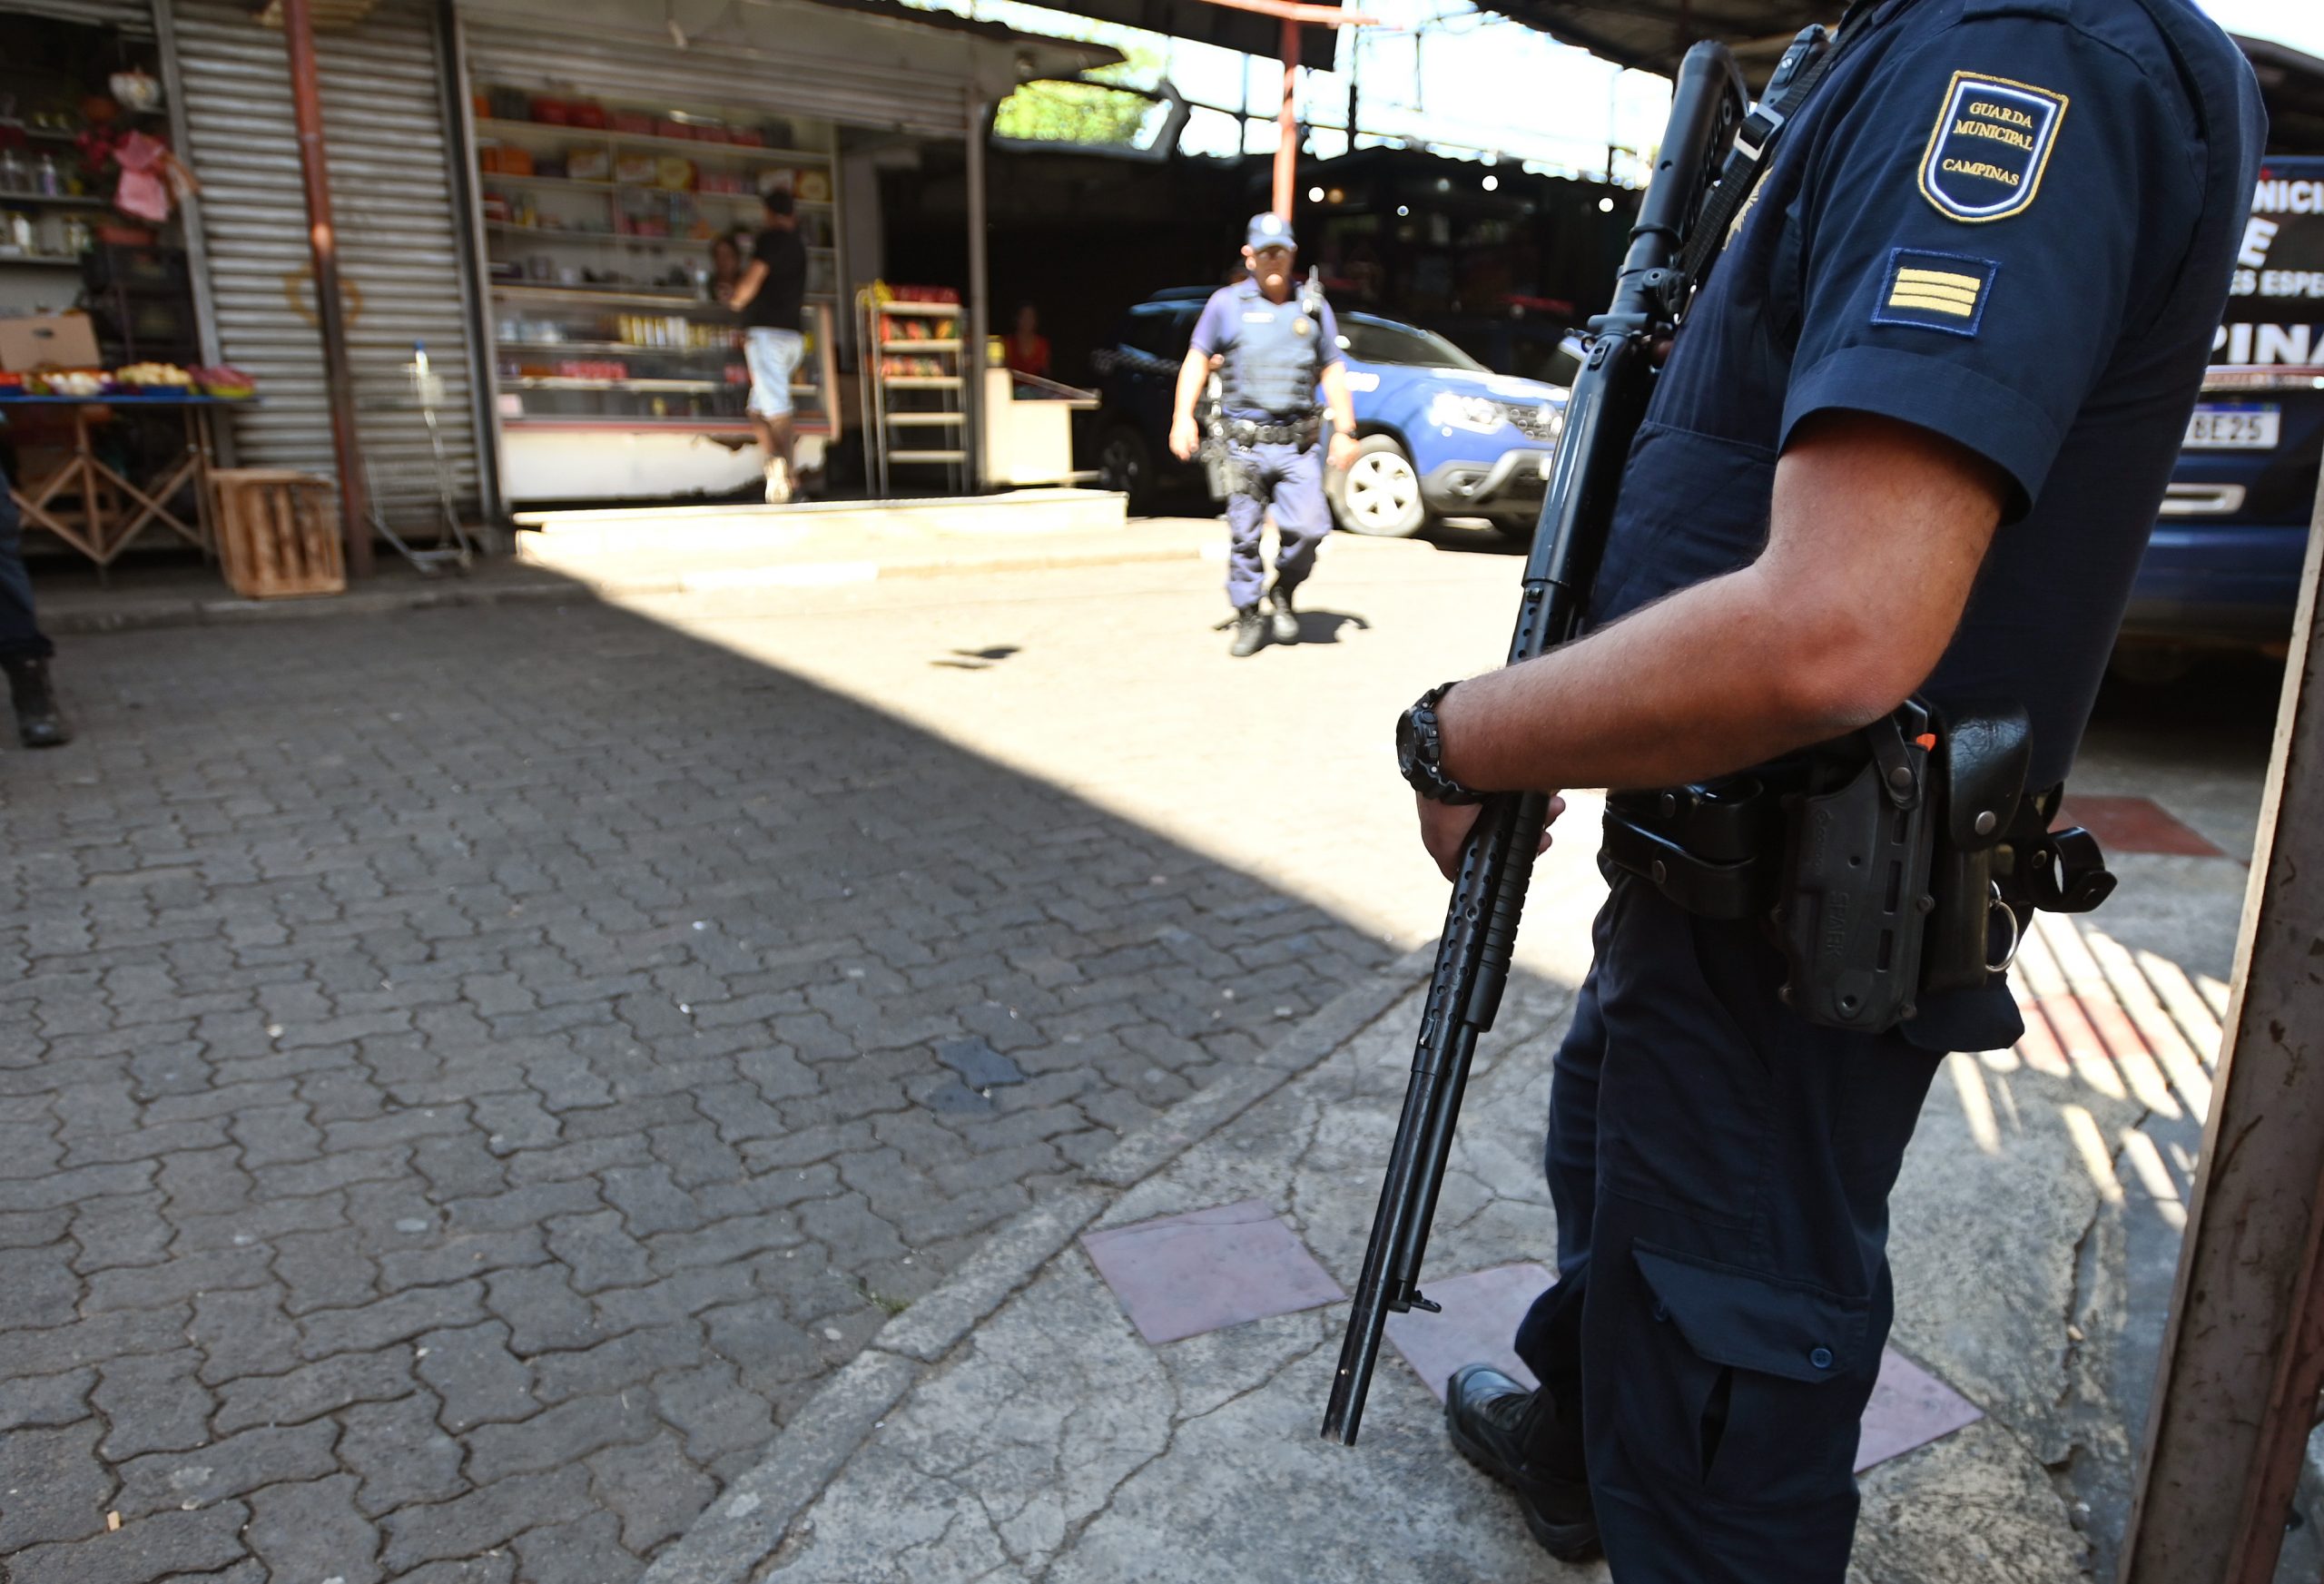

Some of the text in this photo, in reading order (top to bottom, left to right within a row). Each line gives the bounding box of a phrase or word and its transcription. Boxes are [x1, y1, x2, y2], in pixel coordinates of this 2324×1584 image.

[1969, 101, 2033, 128] GUARDA
[1953, 119, 2034, 152] MUNICIPAL
[1942, 158, 2020, 186] CAMPINAS
